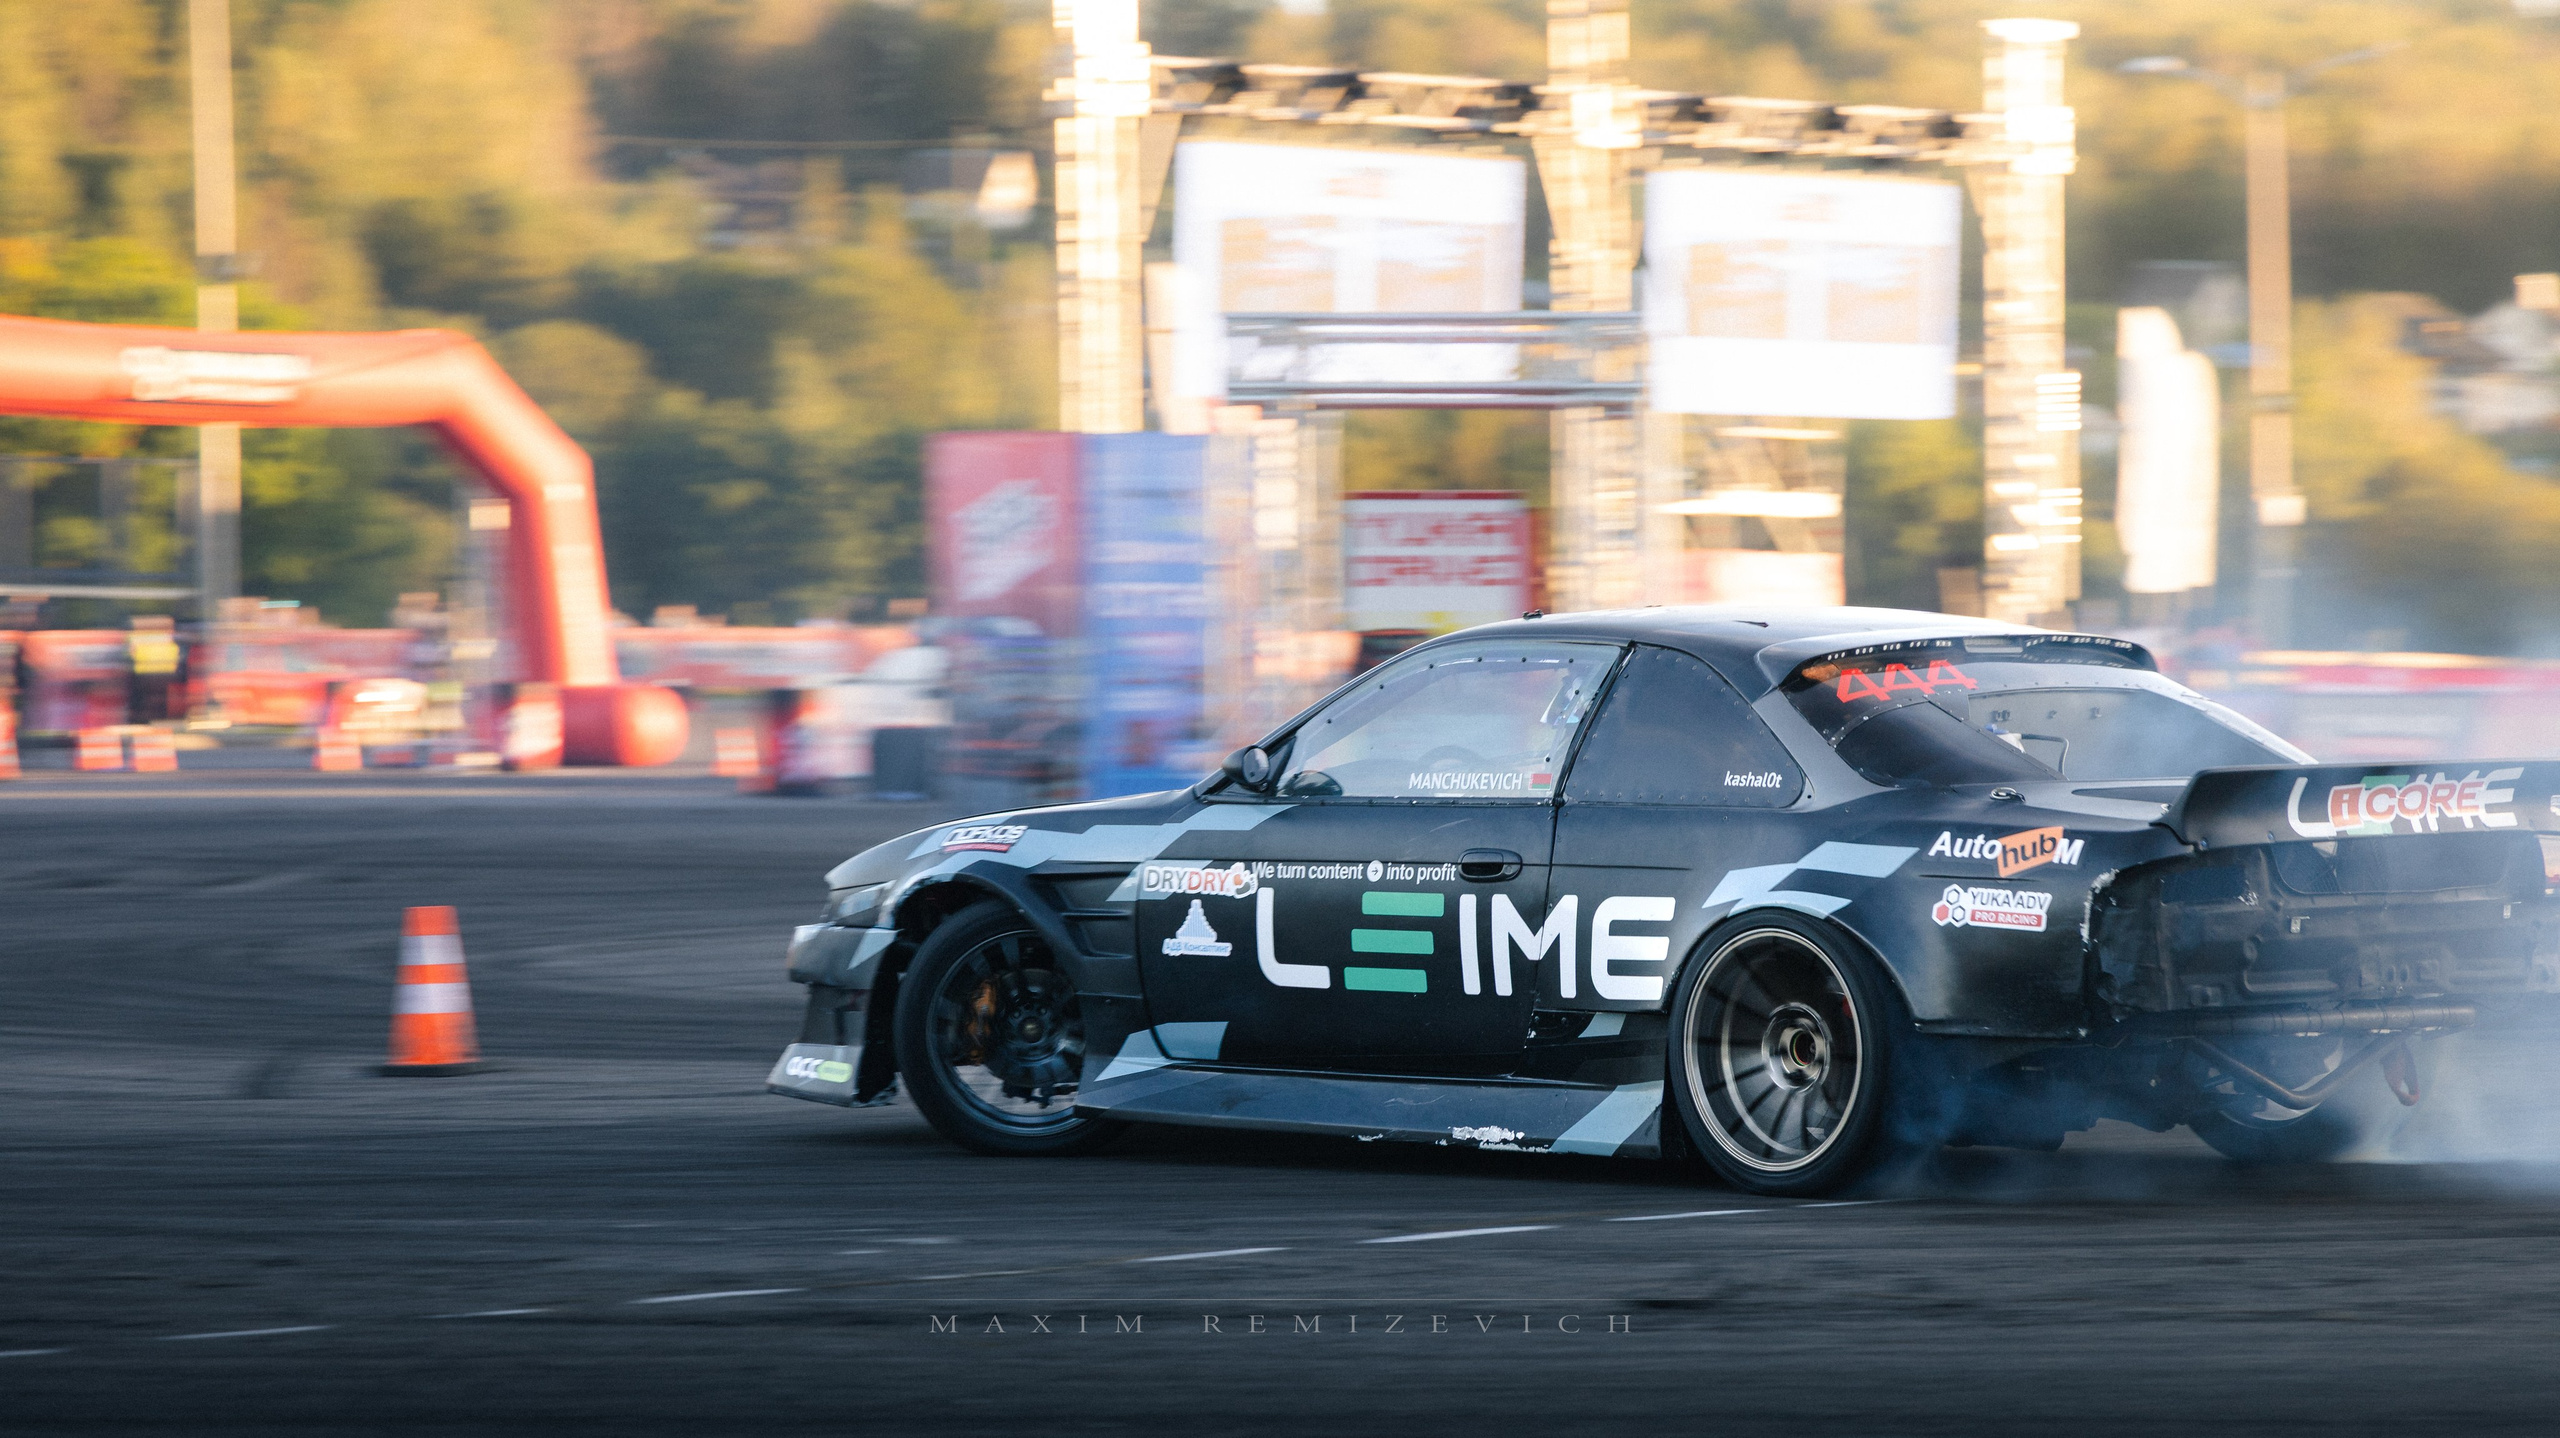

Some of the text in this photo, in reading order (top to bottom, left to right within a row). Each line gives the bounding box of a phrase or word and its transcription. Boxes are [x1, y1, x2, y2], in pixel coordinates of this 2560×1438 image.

[1836, 659, 1979, 703] 444
[1409, 773, 1523, 790] MANCHUKEVICH
[1251, 862, 1456, 884] We turn content into profit
[1971, 890, 2049, 910] YUKA ADV
[1975, 911, 2038, 926] PRO RACING
[1256, 887, 1676, 1000] LEIME
